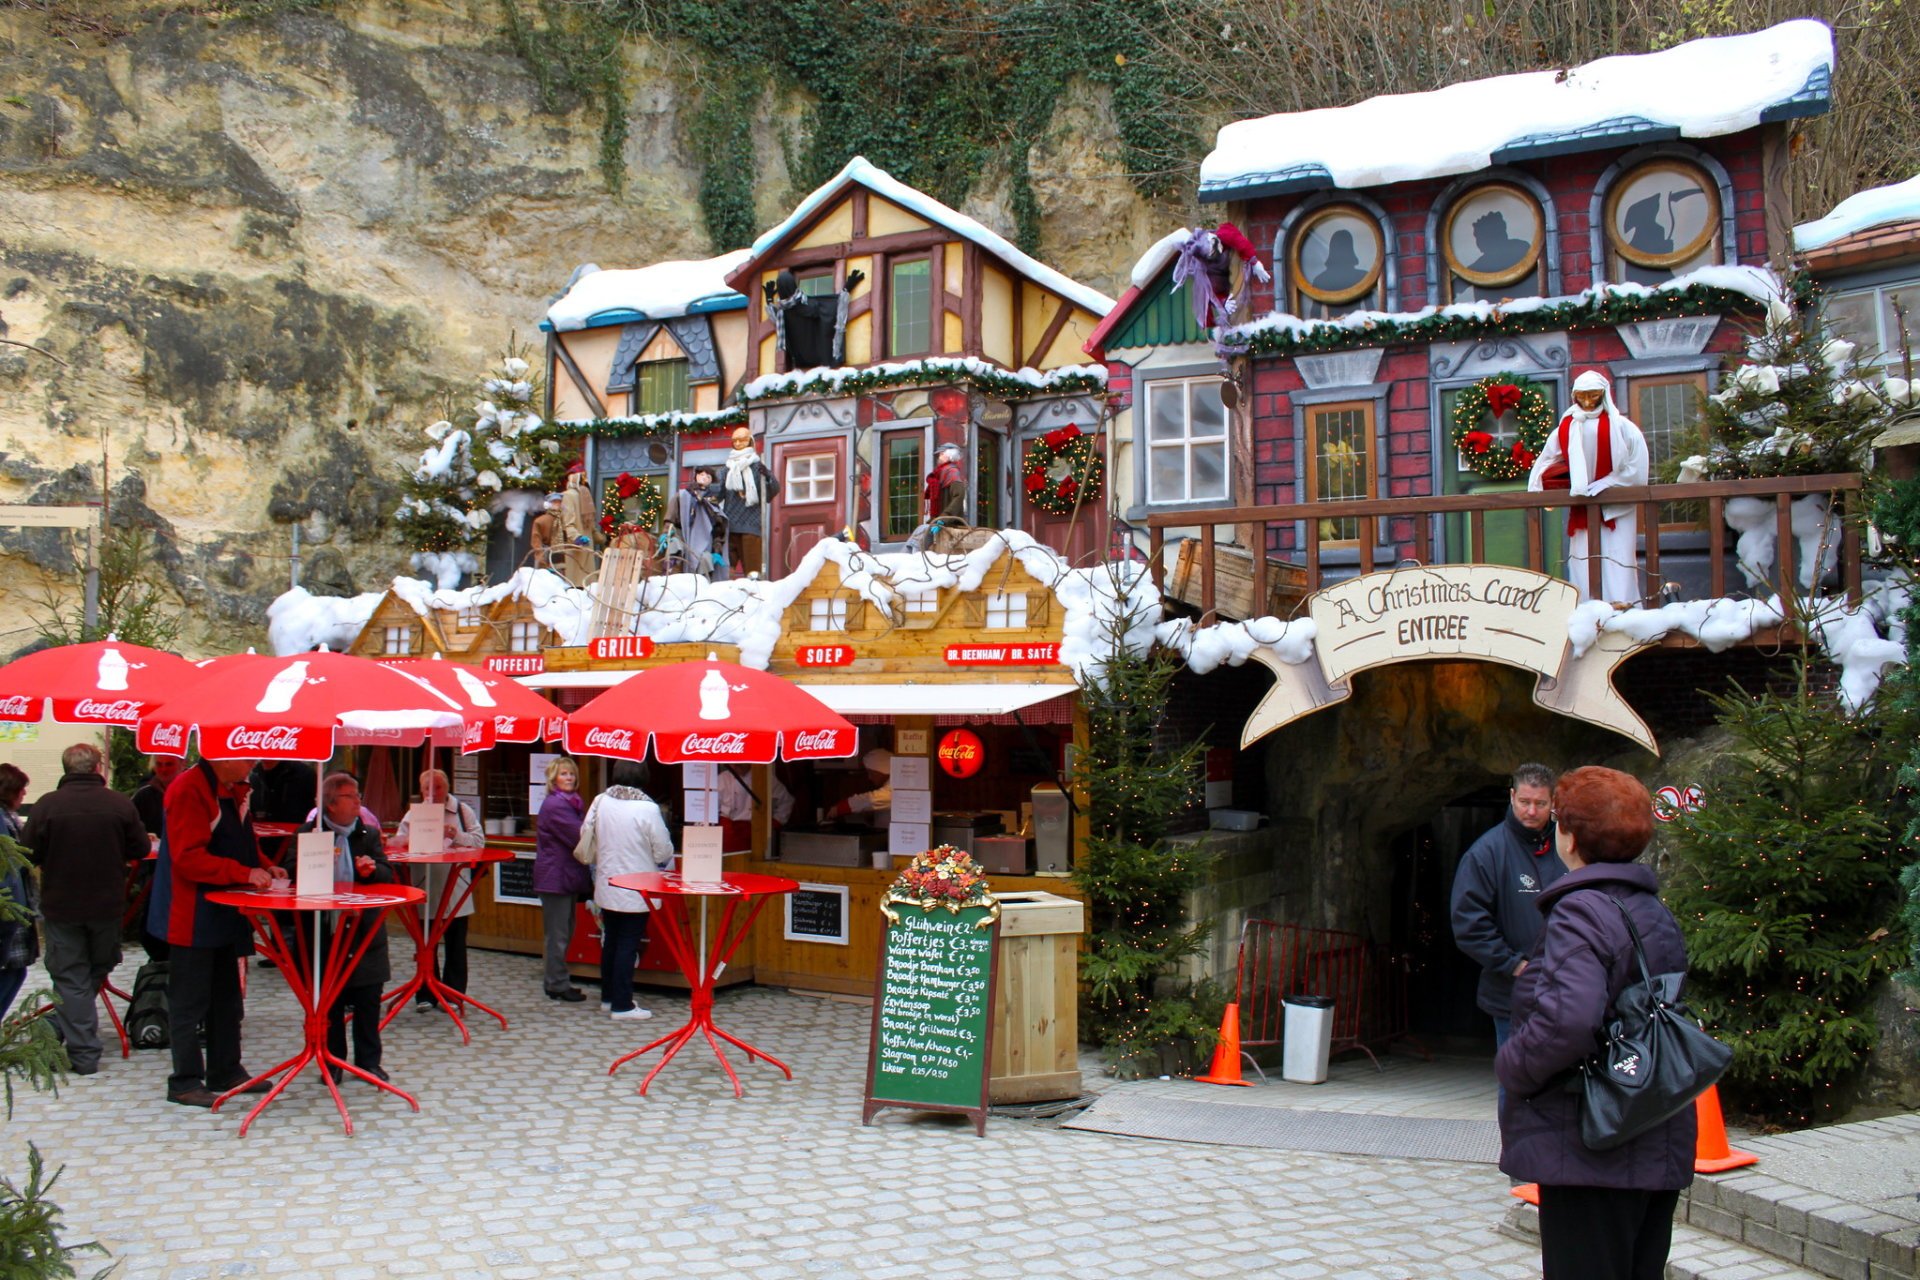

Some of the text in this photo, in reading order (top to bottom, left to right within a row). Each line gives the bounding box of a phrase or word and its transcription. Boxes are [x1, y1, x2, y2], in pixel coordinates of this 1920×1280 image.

[1334, 578, 1549, 630] A Christmas Carol
[1398, 615, 1469, 645] ENTREE
[597, 638, 644, 657] GRILL
[806, 647, 843, 663] SOEP
[1027, 644, 1053, 659] SATÉ
[489, 658, 543, 672] POFFERTJ
[74, 698, 145, 720] Coca-Cola
[151, 723, 184, 748] Coca-Cola
[226, 725, 303, 750] Coca-Cola
[585, 727, 634, 751] Coca-Cola
[681, 732, 749, 755] Coca-Cola
[795, 729, 839, 752] Coca-Cola
[939, 744, 976, 760] Coca-Cola
[905, 915, 954, 936] Glühwein
[890, 930, 945, 950] Poffertjes
[888, 944, 917, 958] Warme
[887, 956, 919, 973] Broodje
[920, 960, 955, 977] Beenham
[886, 968, 919, 984] Broodje
[919, 974, 961, 991] Hamburger
[886, 983, 918, 999] Broodje
[919, 986, 950, 1000] Kipsaté
[883, 995, 931, 1013] Erwtensoep
[897, 1008, 922, 1020] broodje
[923, 1012, 933, 1021] en
[934, 1013, 960, 1025] worst)
[881, 1016, 916, 1034] Broodje
[919, 1022, 958, 1038] Grillworst
[881, 1047, 917, 1066] Slagroom
[881, 1062, 906, 1074] Likeur
